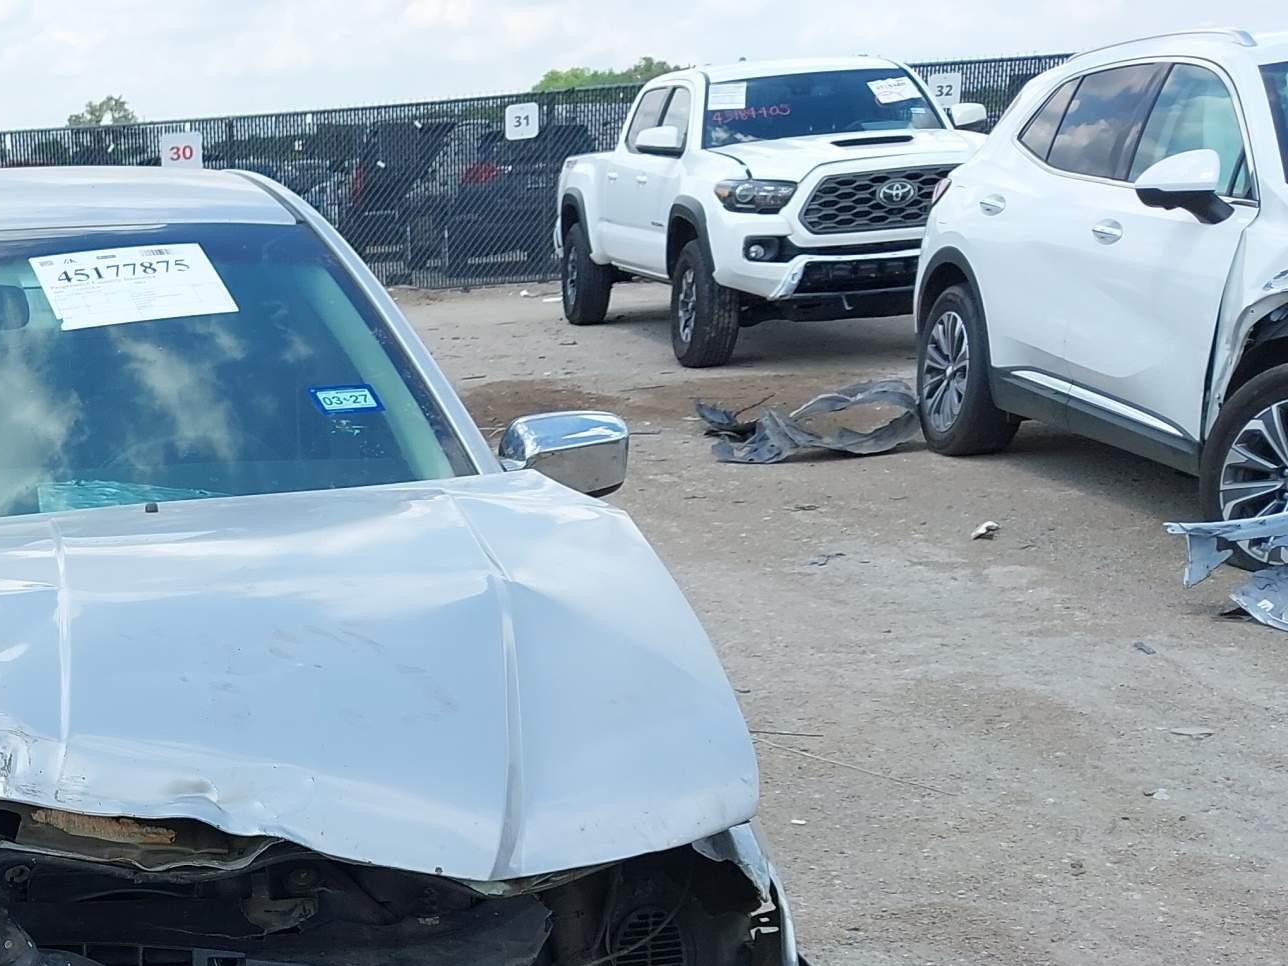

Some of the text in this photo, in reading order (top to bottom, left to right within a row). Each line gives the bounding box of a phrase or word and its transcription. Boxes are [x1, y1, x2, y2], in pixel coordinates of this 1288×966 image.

[935, 84, 953, 97] 32
[514, 114, 530, 128] 31
[169, 145, 193, 161] 30
[57, 258, 190, 283] 45177875
